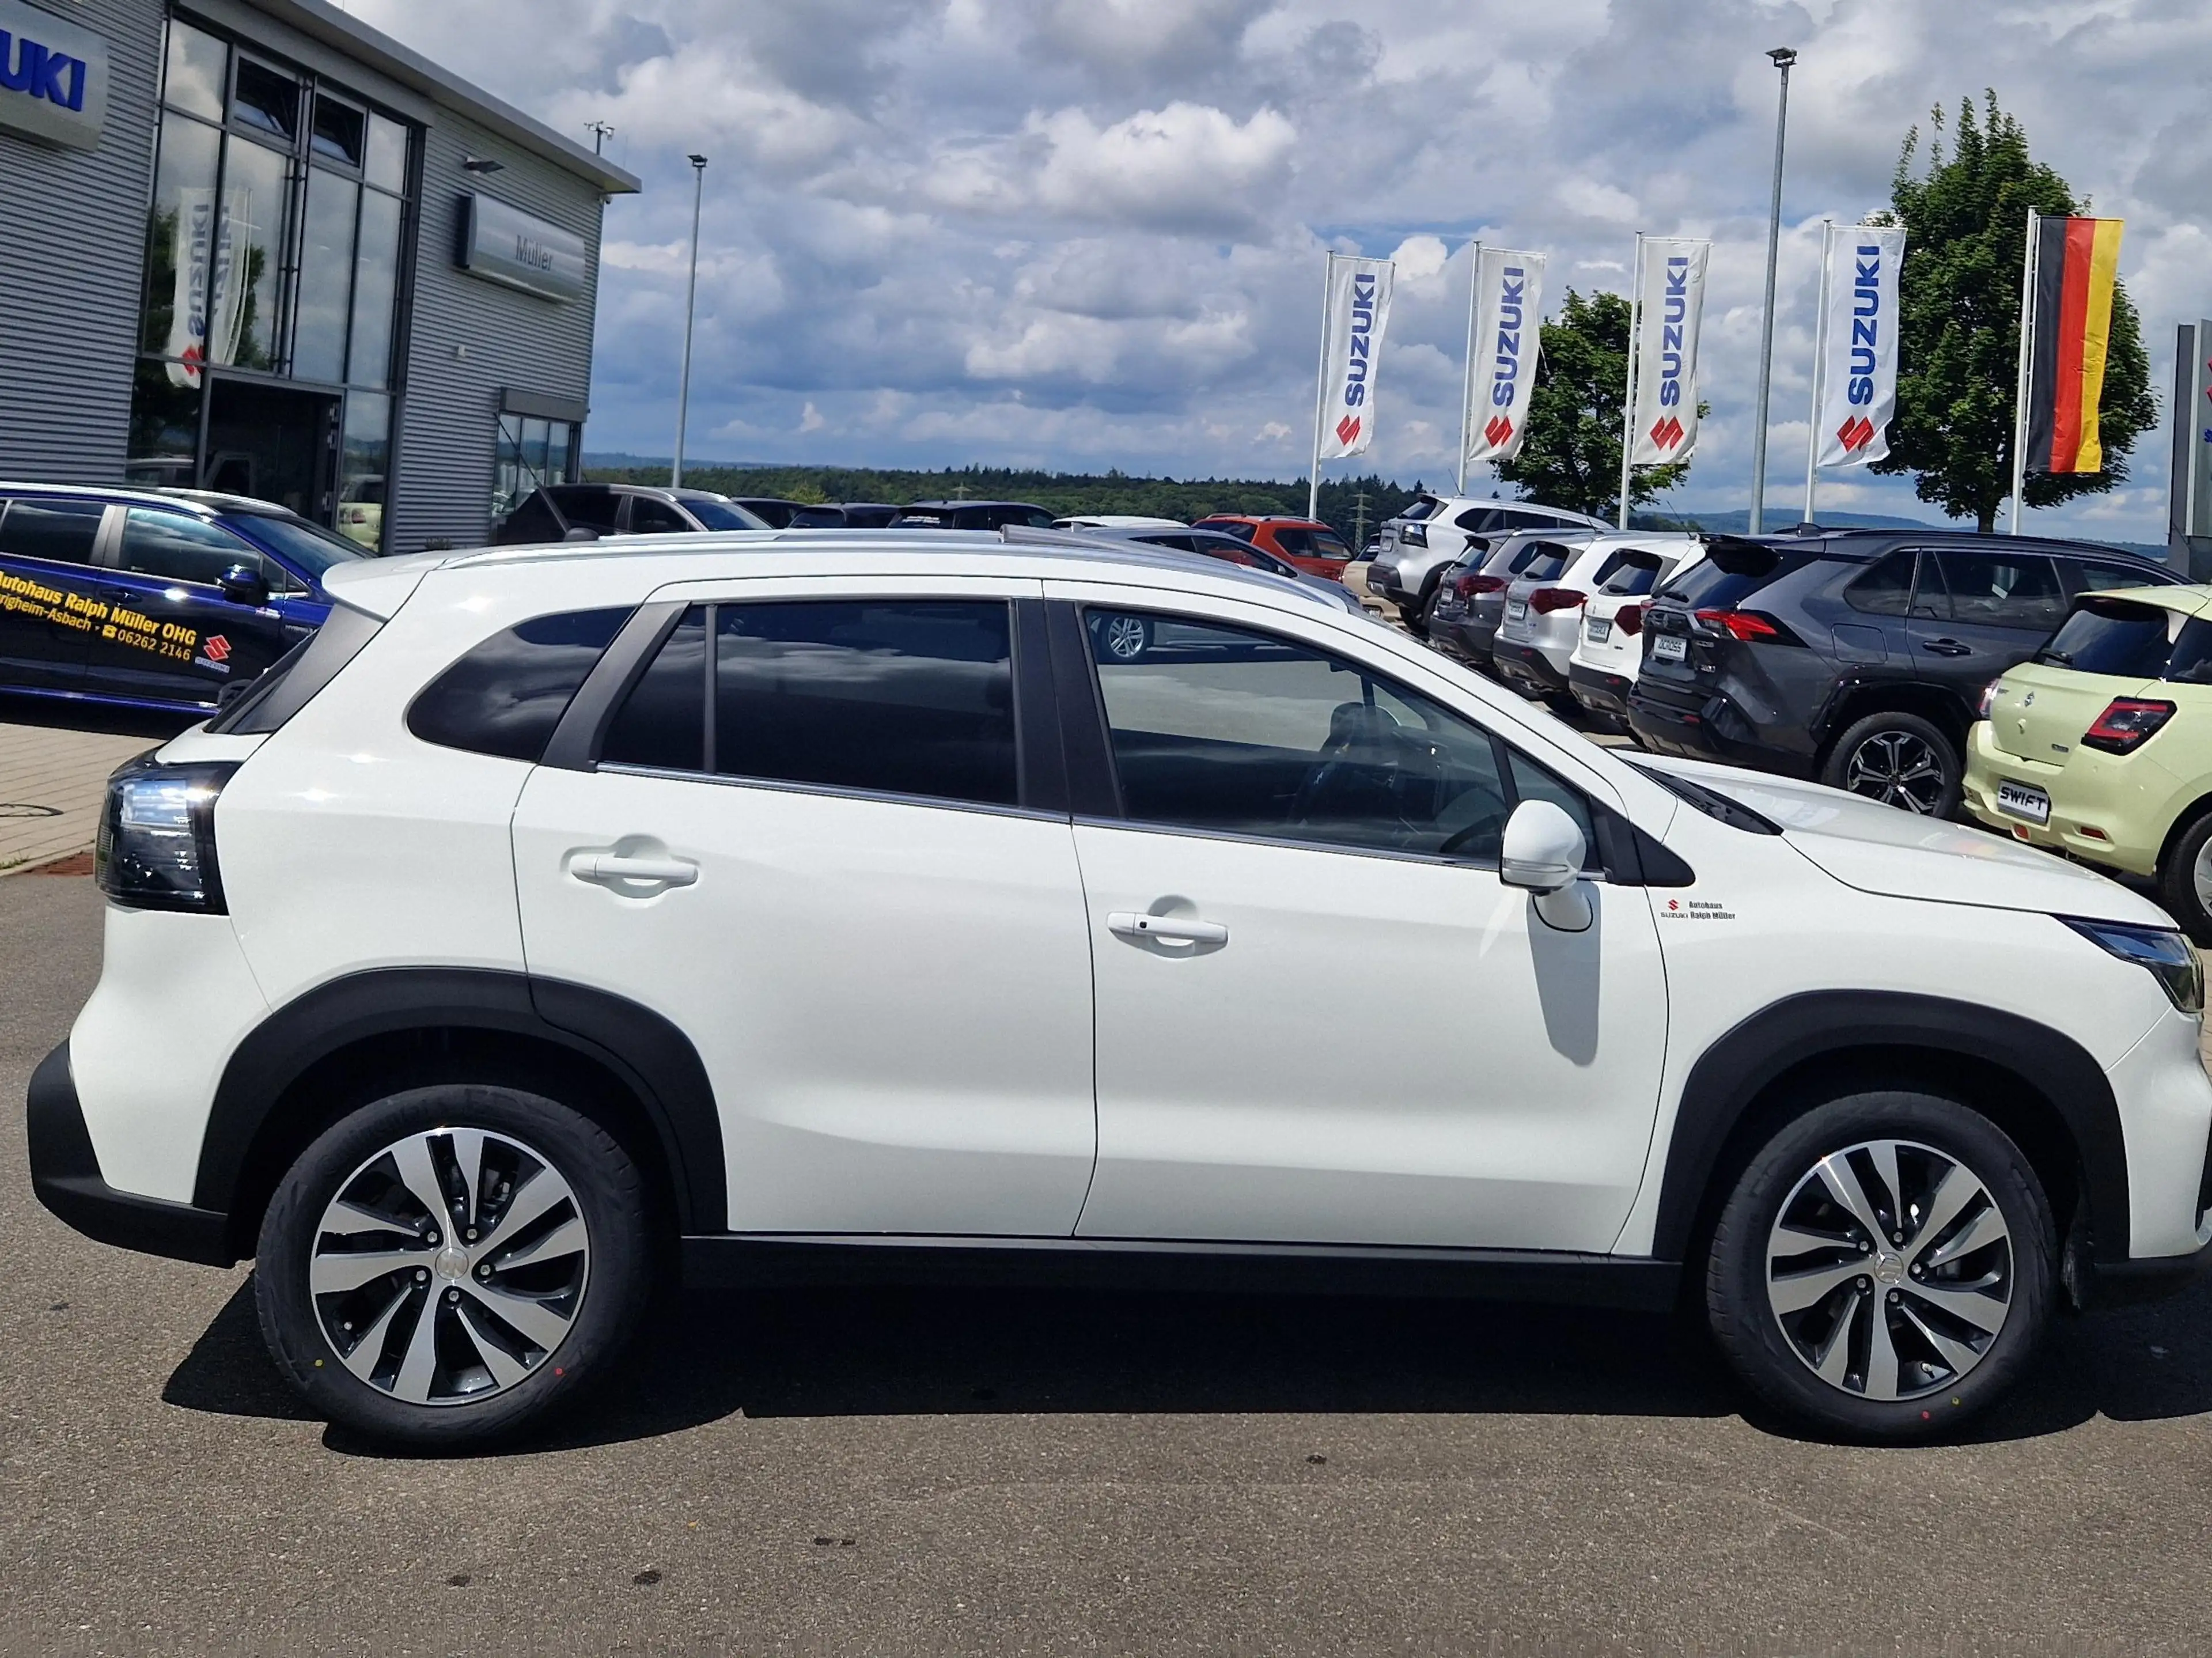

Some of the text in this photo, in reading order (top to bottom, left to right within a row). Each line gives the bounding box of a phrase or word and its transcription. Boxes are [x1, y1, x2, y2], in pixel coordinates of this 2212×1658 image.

[516, 234, 552, 271] Müller
[1344, 274, 1375, 407] SUZUKI
[1493, 267, 1524, 407] SUZUKI
[1660, 257, 1689, 407] SUZUKI
[1848, 245, 1880, 405] SUZUKI
[65, 592, 108, 619] Ralph
[110, 606, 160, 634] Müller
[162, 623, 197, 646] OHG
[118, 629, 157, 652] 06262
[159, 642, 191, 661] 2146
[1658, 638, 1682, 653] ACROSS
[1999, 786, 2046, 811] SWIFT
[1689, 900, 1722, 909] Autohaus
[1690, 911, 1735, 919] Ralph Müller
